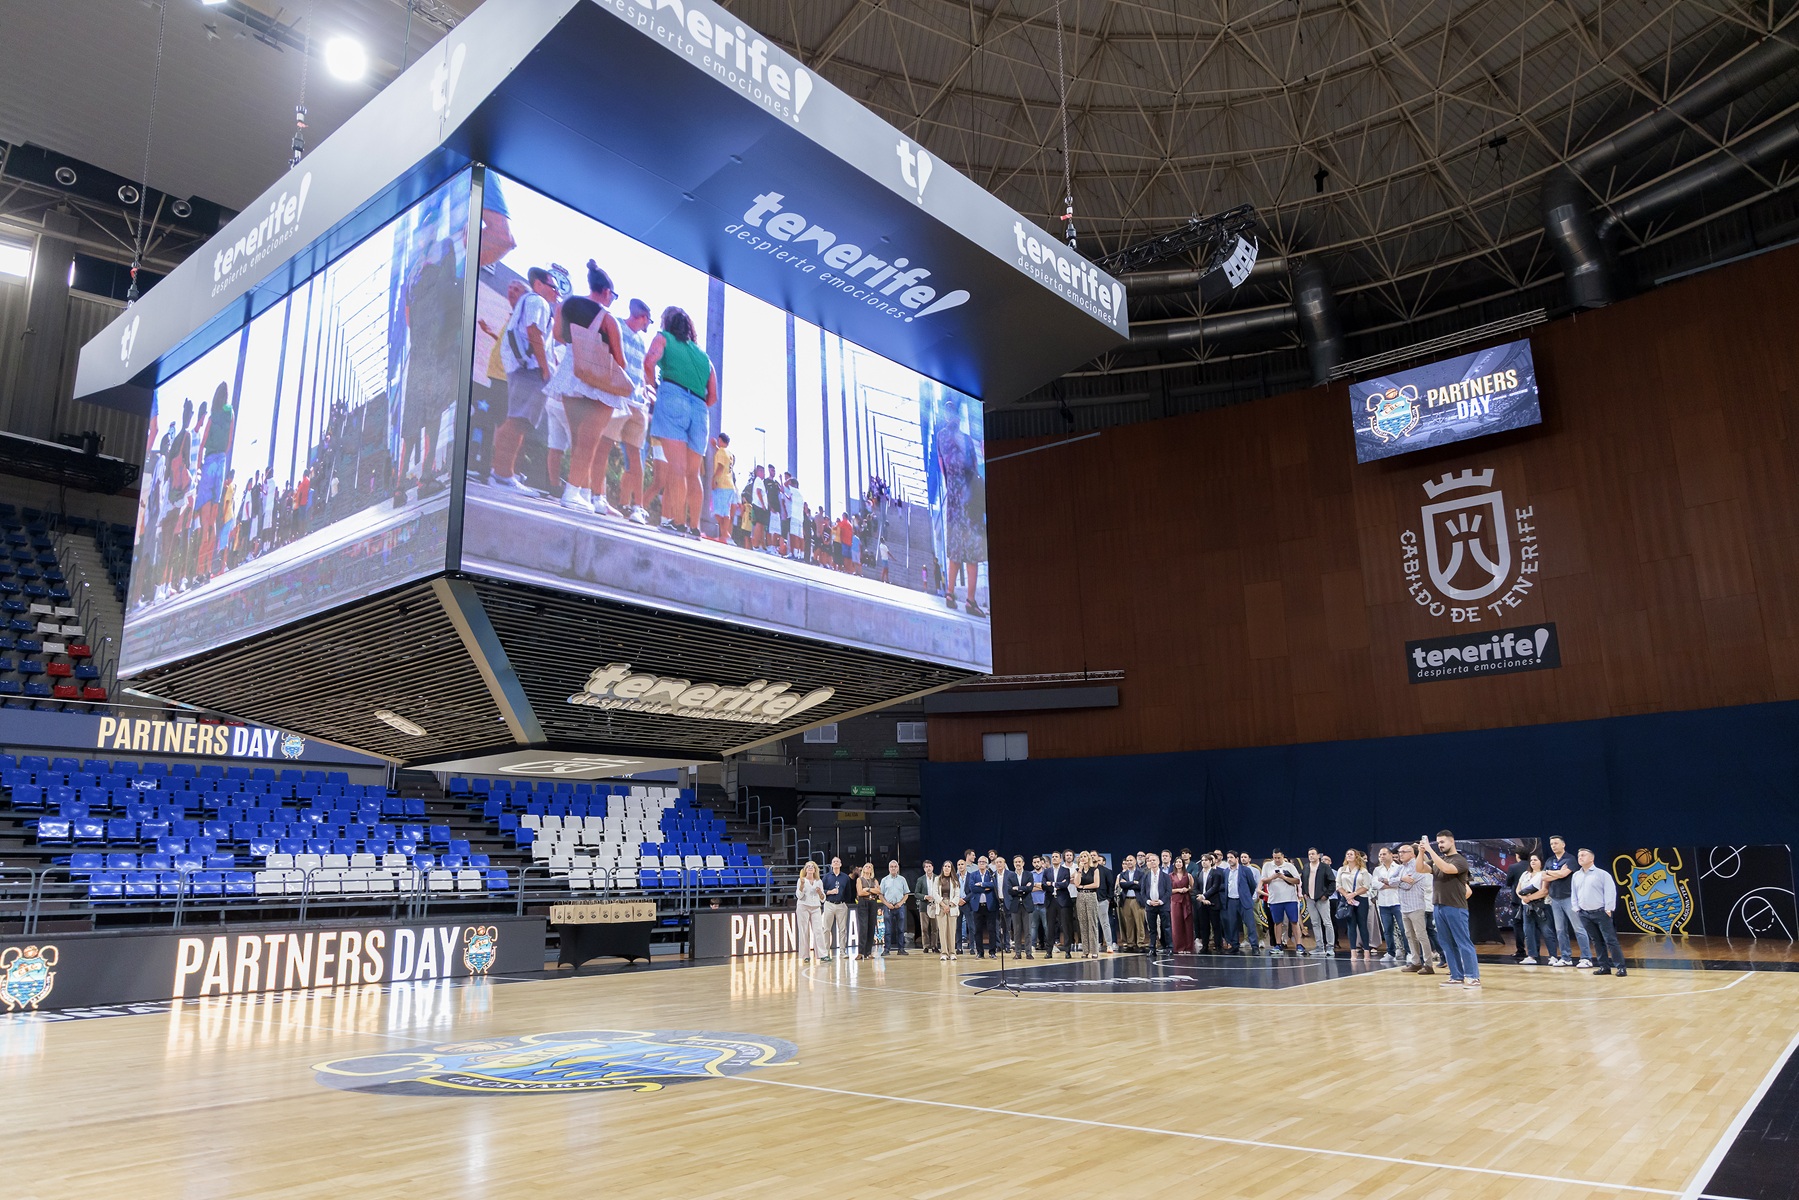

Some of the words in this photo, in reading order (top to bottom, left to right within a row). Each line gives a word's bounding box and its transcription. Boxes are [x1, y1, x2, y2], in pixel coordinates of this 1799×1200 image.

[430, 42, 467, 119] t!
[703, 55, 790, 117] emociones
[896, 138, 933, 205] t!
[213, 171, 312, 282] tenerife!
[743, 190, 971, 323] tenerife!
[211, 263, 248, 298] despierta
[250, 226, 294, 268] emociones
[724, 222, 817, 274] despierta
[819, 271, 905, 320] emociones
[1013, 220, 1122, 327] tenerife!
[1018, 255, 1063, 293] despierta
[1066, 288, 1112, 324] emociones
[120, 314, 140, 368] t!
[1427, 368, 1519, 409] PARTNERS
[1456, 393, 1492, 420] DAY
[1400, 529, 1446, 617] CABILDO
[1450, 606, 1481, 623] DE
[1487, 505, 1539, 617] TENERIFE
[1412, 627, 1550, 669] tenerife!
[1417, 665, 1469, 678] despierta
[1474, 657, 1534, 672] emociones
[97, 716, 229, 756] PARTNERS
[232, 726, 280, 758] DAY
[569, 692, 673, 714] despierta
[172, 929, 386, 999] PARTNERS
[391, 926, 461, 982] DAY
